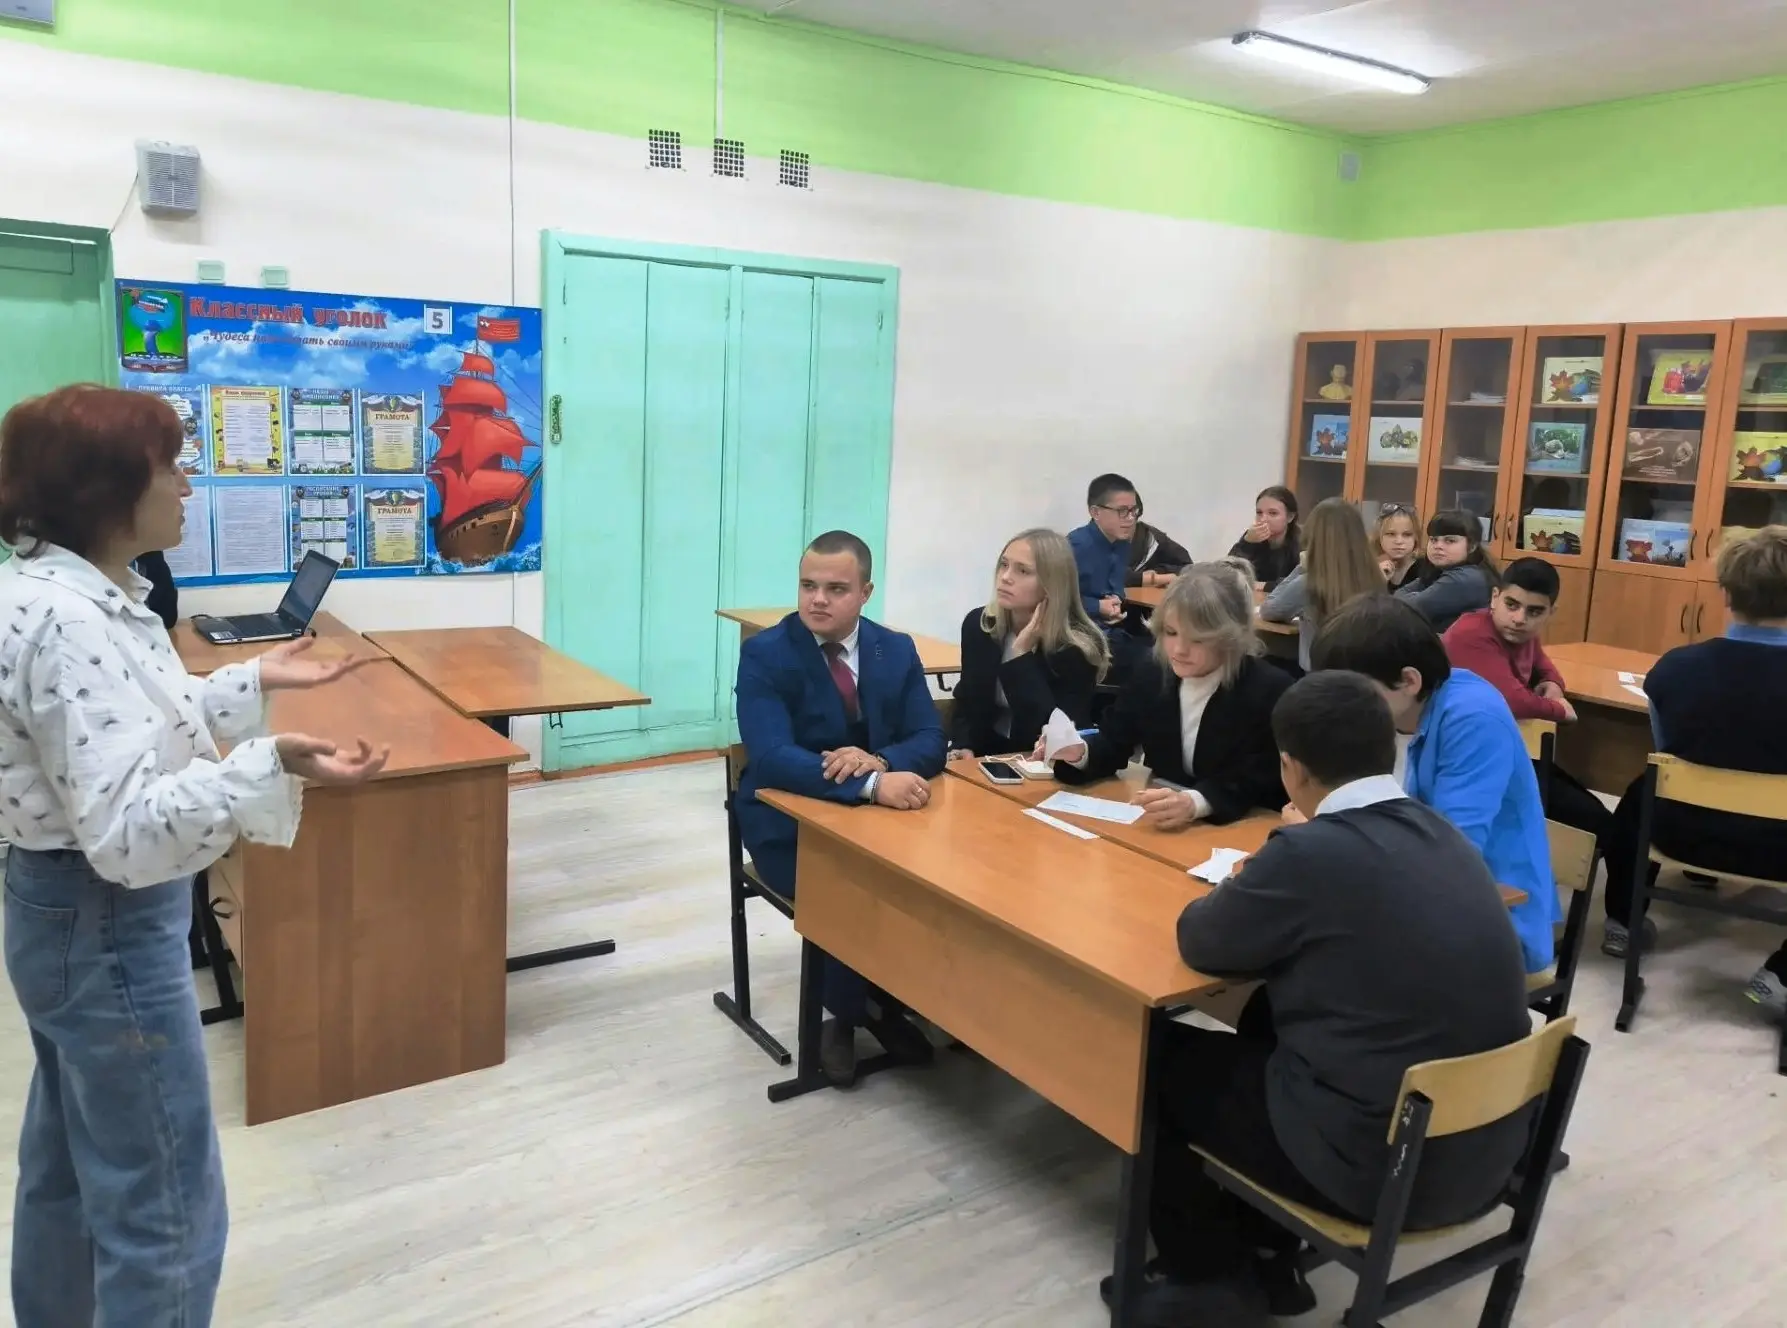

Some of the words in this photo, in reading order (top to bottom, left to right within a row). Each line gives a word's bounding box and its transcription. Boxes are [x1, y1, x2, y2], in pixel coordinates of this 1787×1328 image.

[190, 296, 304, 323] Классный
[313, 308, 388, 329] уголок
[431, 311, 444, 329] 5
[375, 413, 410, 421] ГРАМОТА
[377, 507, 413, 515] ГРАМОТА
